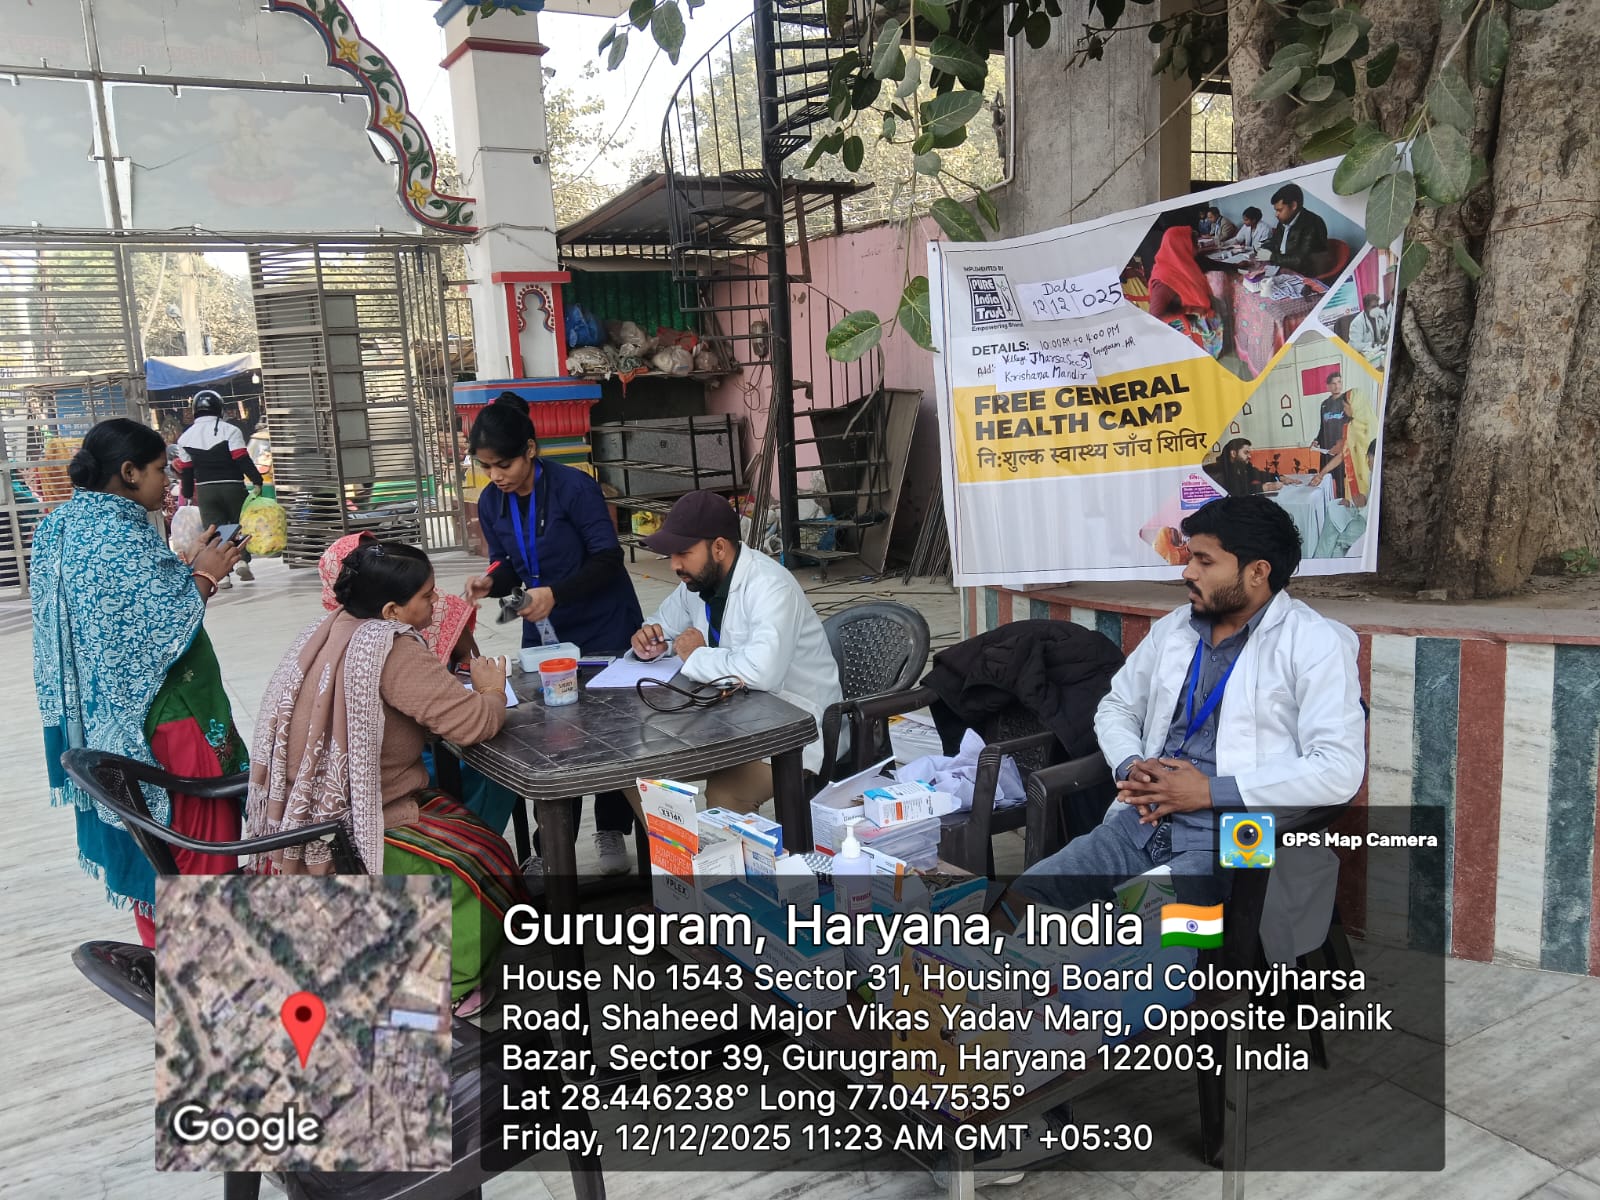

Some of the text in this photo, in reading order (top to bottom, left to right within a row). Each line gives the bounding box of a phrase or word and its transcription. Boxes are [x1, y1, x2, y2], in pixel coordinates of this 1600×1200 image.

[971, 279, 995, 291] PURE
[1041, 280, 1084, 296] Date
[974, 293, 1001, 306] India
[972, 341, 1030, 356] DETAILS:
[1052, 364, 1088, 381] Mandir
[975, 373, 1190, 416] FREE GENERAL
[976, 400, 1182, 441] HEALTH CAMP
[1050, 443, 1108, 464] स्वास्थ्य
[1113, 432, 1152, 458] जाँच
[1156, 427, 1208, 454] शिविर
